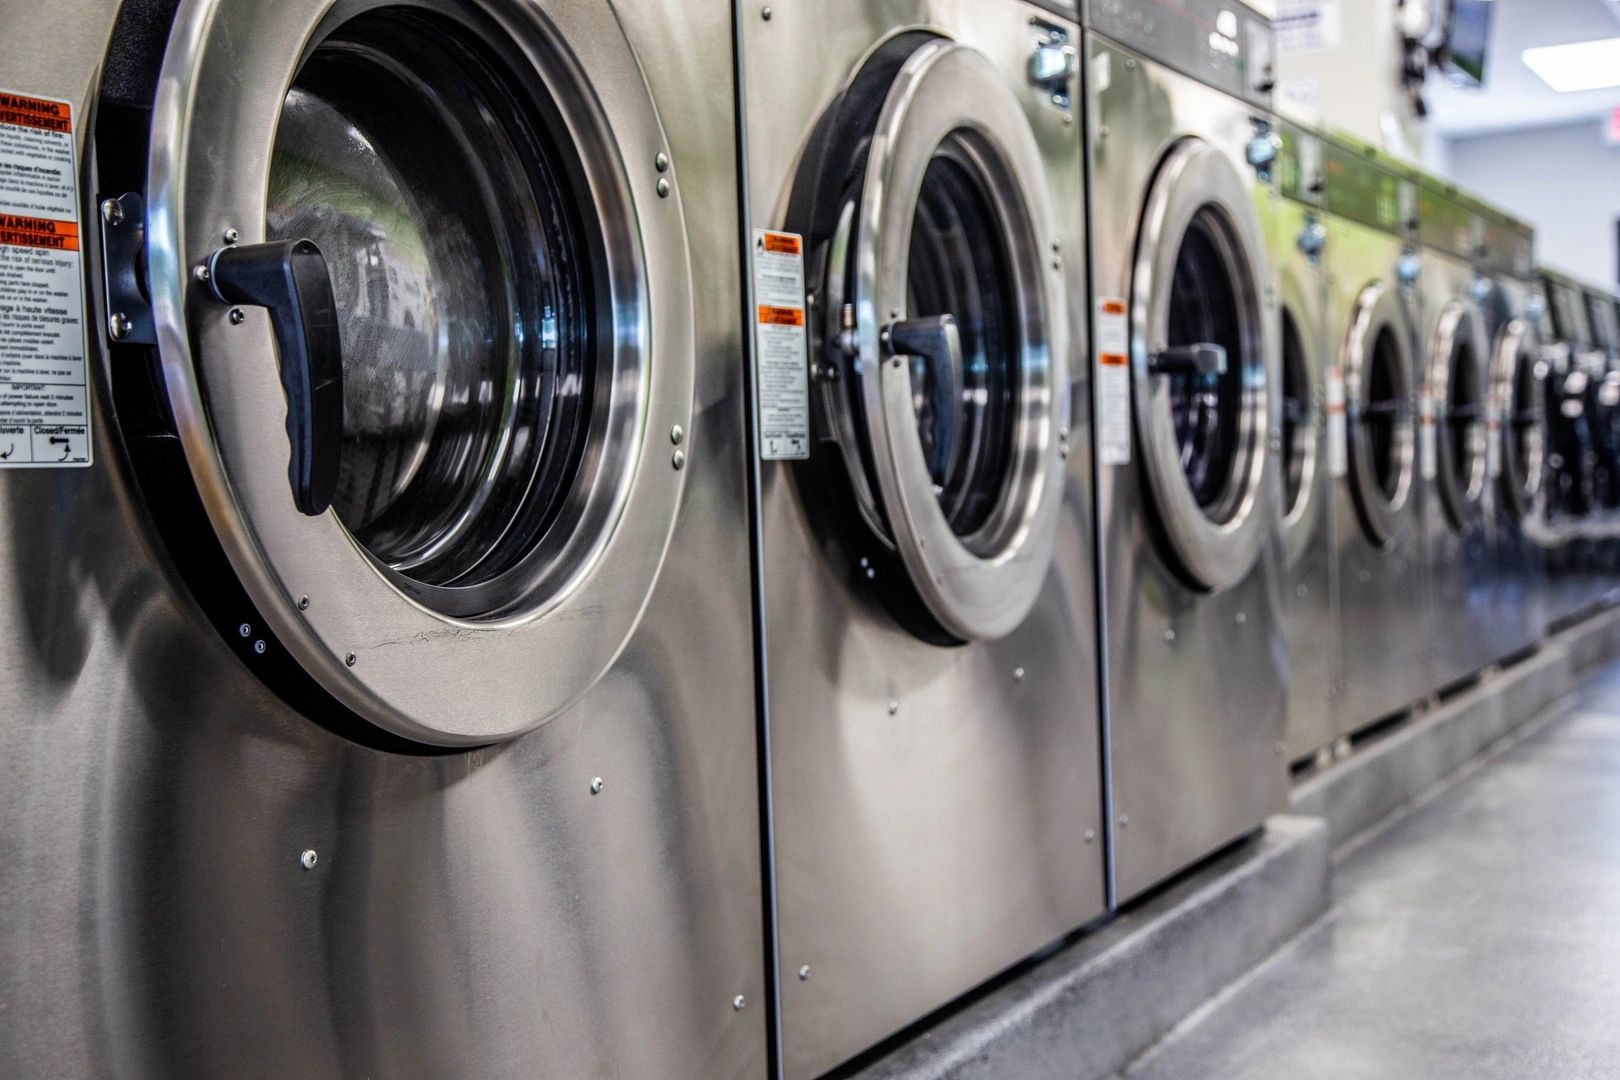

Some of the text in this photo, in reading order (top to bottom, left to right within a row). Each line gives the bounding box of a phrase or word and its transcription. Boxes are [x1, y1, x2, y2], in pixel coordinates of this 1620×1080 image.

[0, 95, 59, 115] WARNING
[12, 247, 33, 256] speed
[22, 304, 42, 314] haute
[44, 306, 68, 315] vitesse
[34, 426, 85, 434] Closed/Fermée
